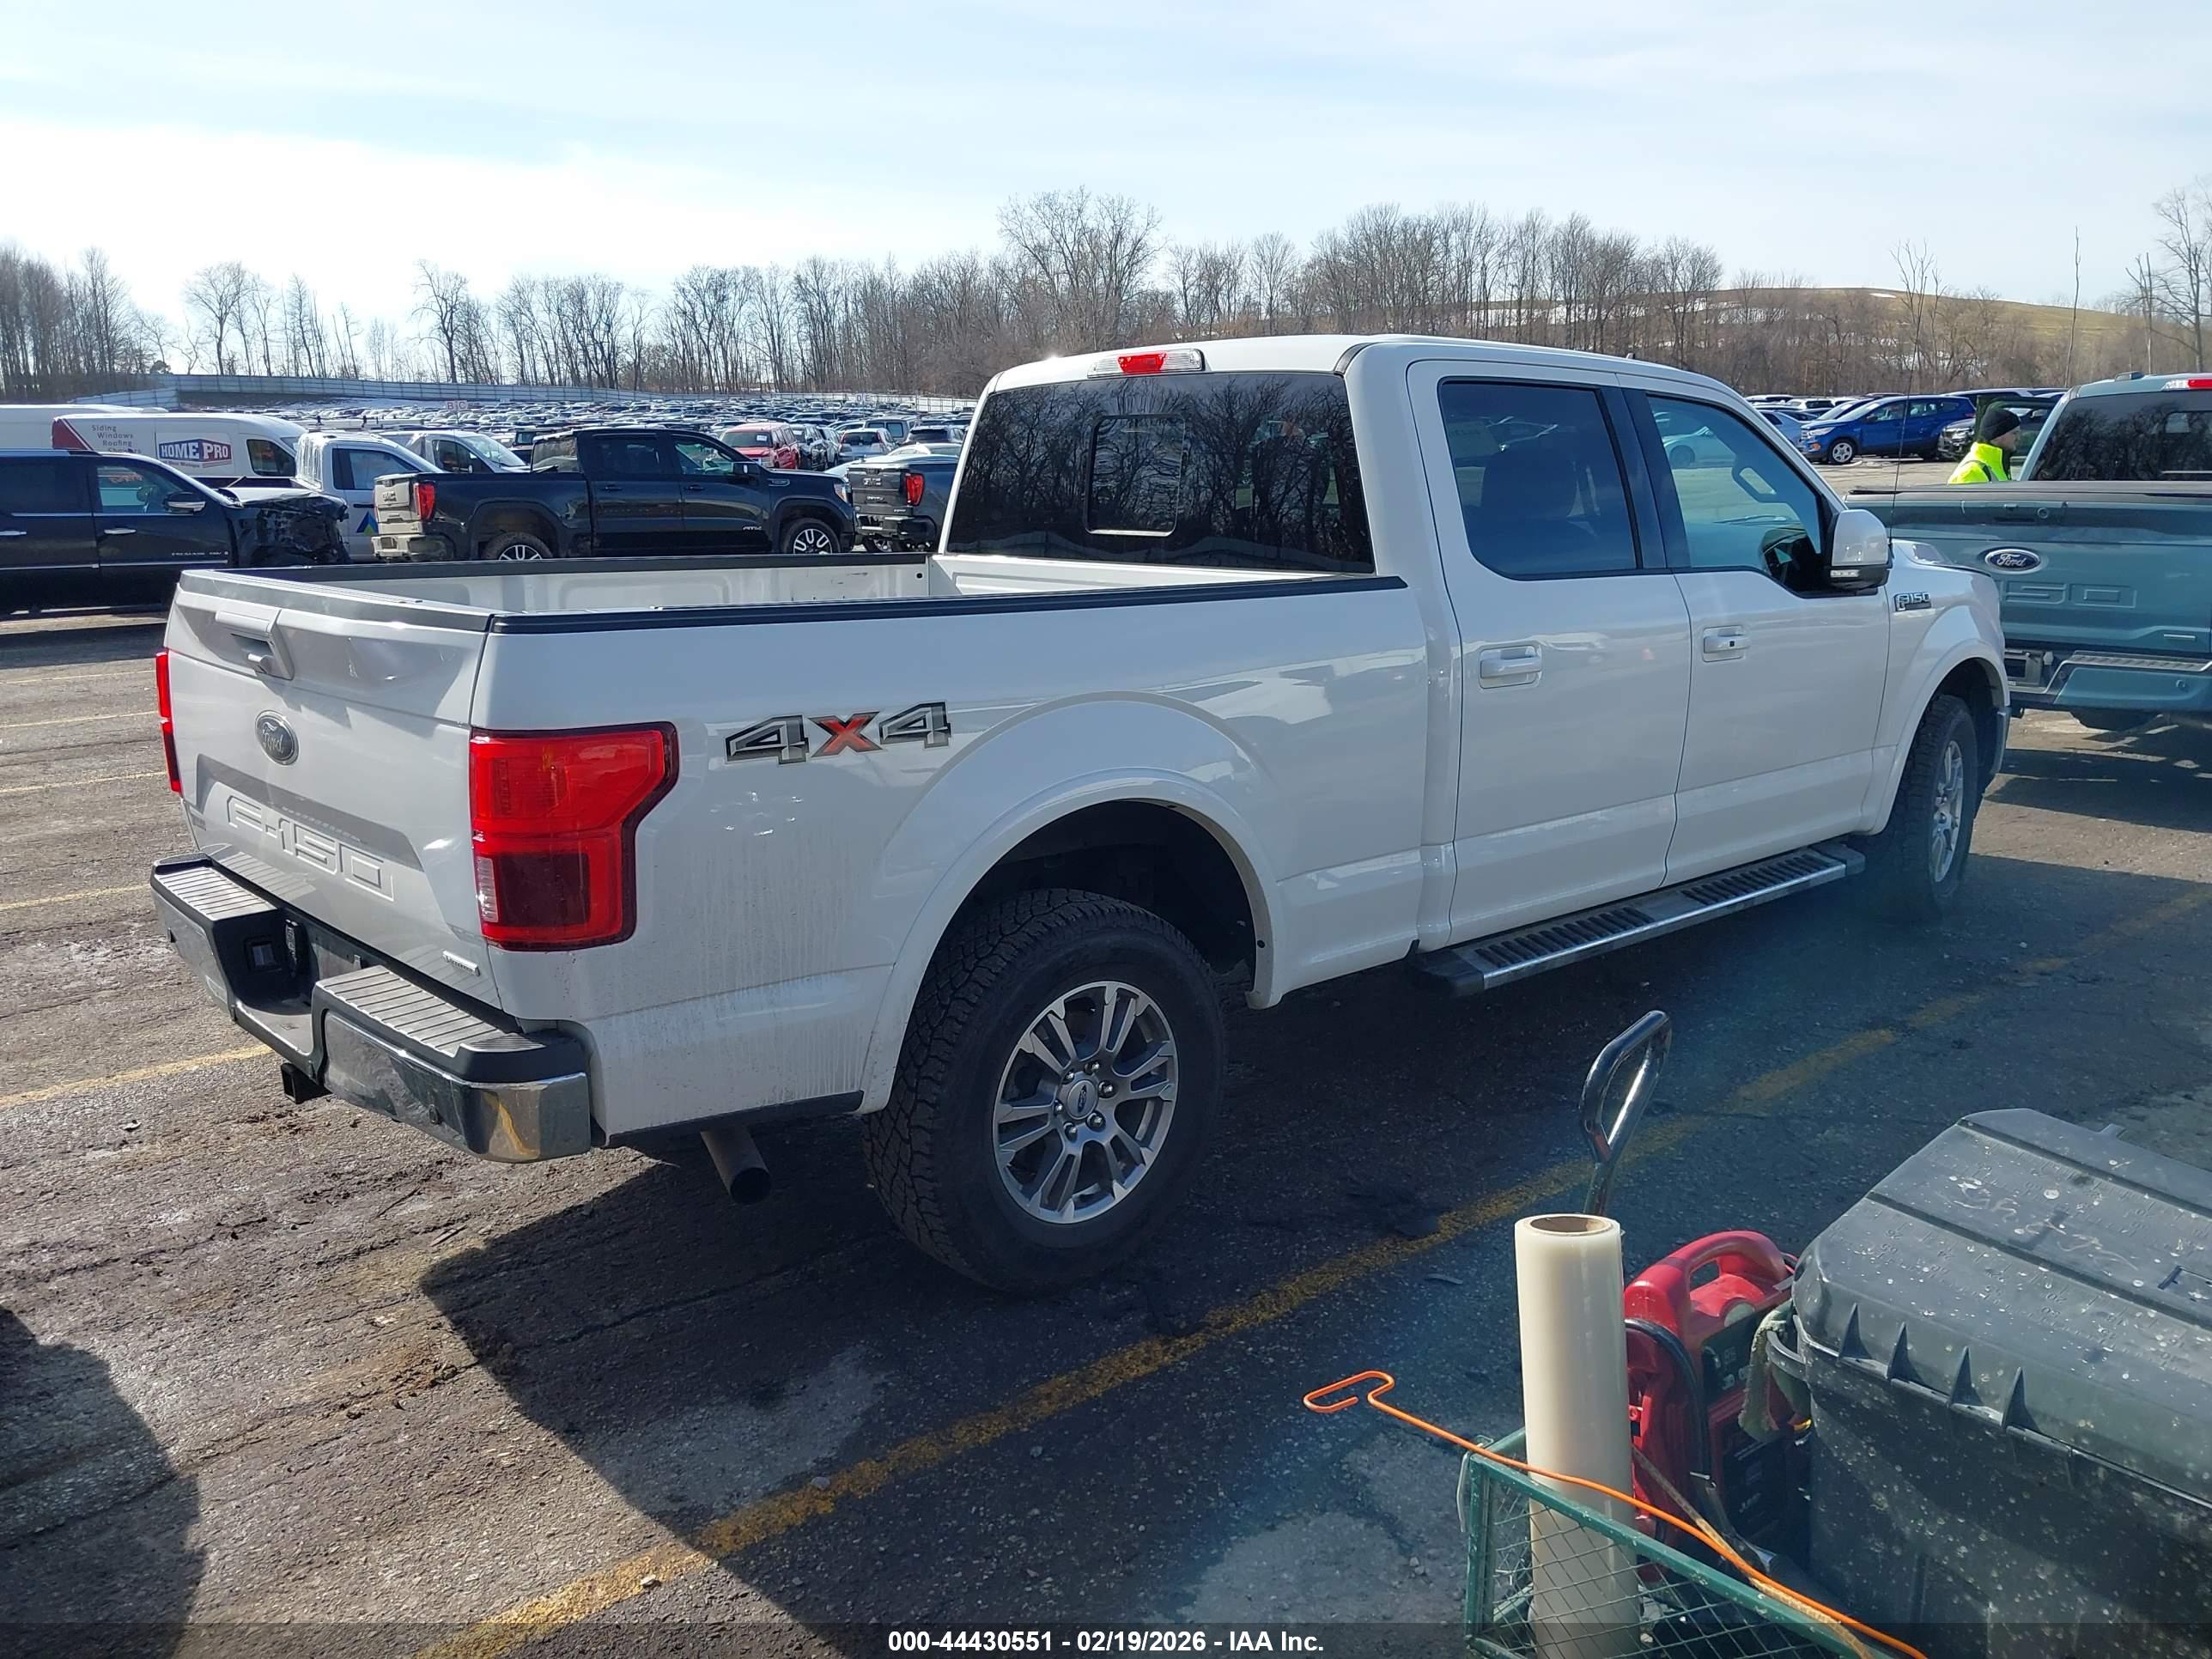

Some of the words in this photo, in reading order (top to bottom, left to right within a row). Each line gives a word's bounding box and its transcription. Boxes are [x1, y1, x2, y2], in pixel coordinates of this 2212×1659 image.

[161, 441, 200, 459] HOME
[202, 442, 228, 459] PRO
[725, 701, 952, 765] 4X4
[226, 794, 395, 902] F-150
